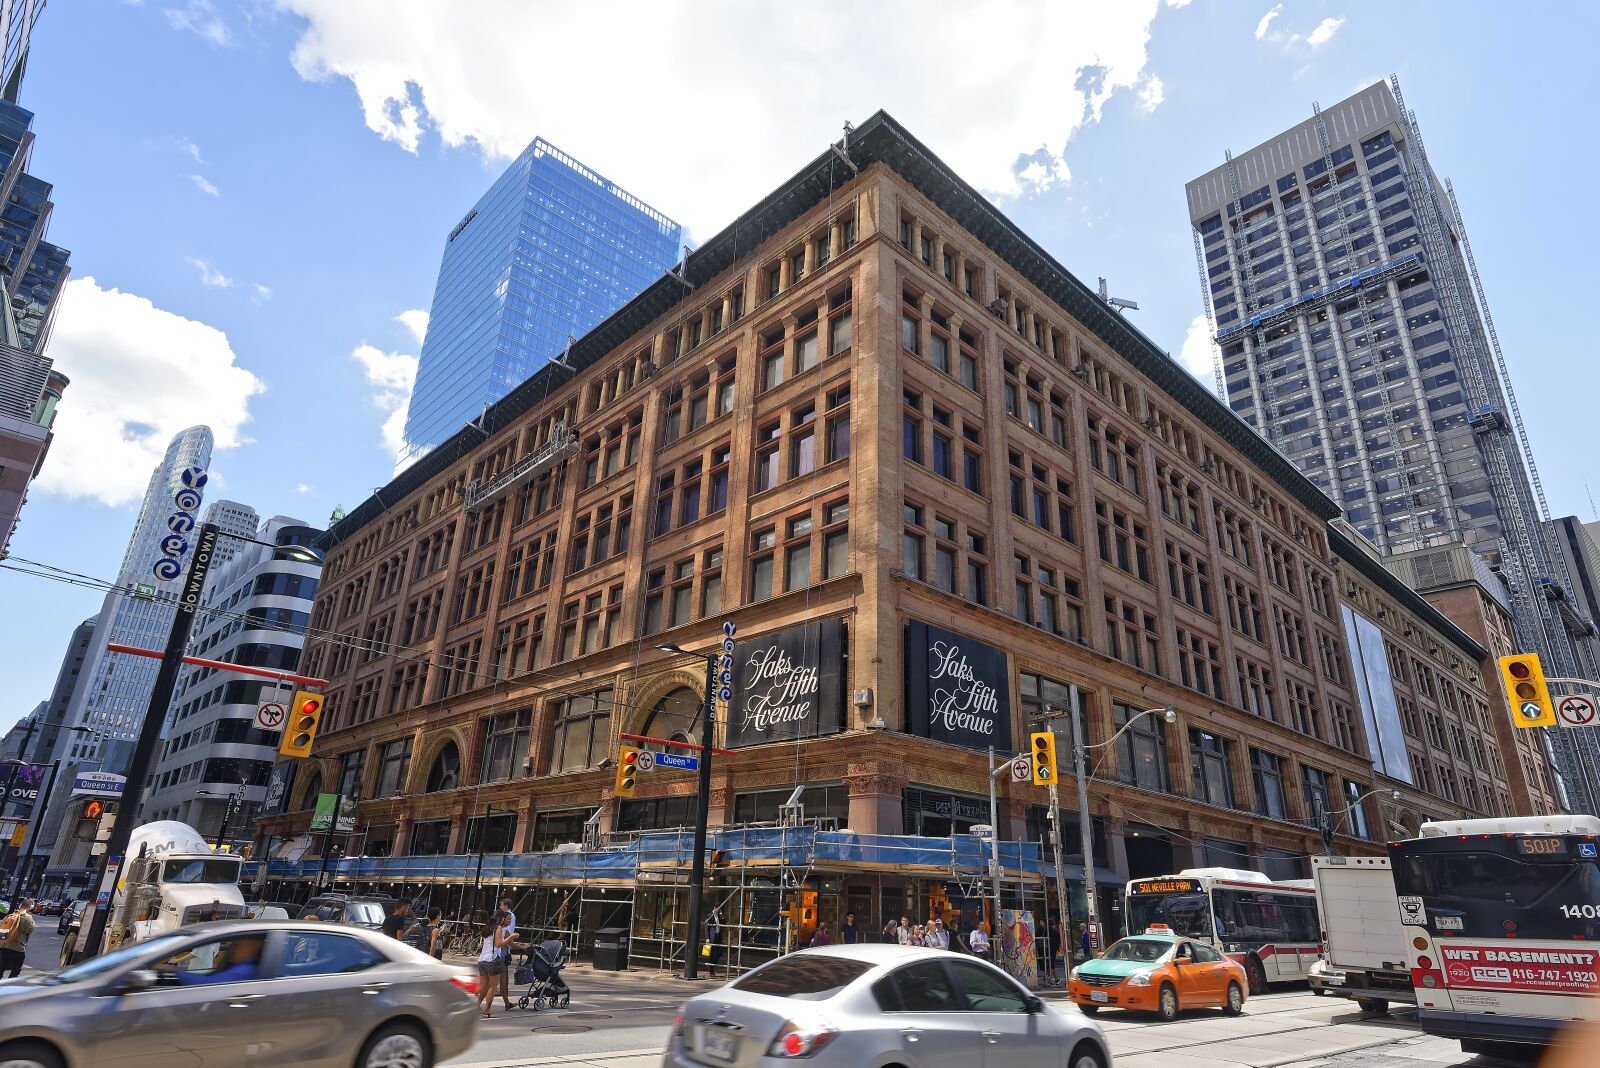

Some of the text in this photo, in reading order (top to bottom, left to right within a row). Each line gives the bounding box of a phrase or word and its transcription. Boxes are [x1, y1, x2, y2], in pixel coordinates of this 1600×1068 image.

[184, 531, 215, 613] DOWNTOWN
[744, 645, 793, 690] Saks
[929, 641, 974, 685] Saks
[709, 659, 718, 719] DOWNTOWN
[741, 694, 810, 731] Avenue
[930, 688, 994, 734] Avenue
[663, 754, 686, 766] Queen
[81, 780, 106, 788] Queen
[1522, 838, 1561, 855] 501P
[1140, 881, 1191, 893] 501 NEVILLE PARK
[1444, 949, 1594, 965] WET BASEMENT?
[1474, 968, 1508, 978] RCC
[1512, 968, 1598, 983] 416-747-1920
